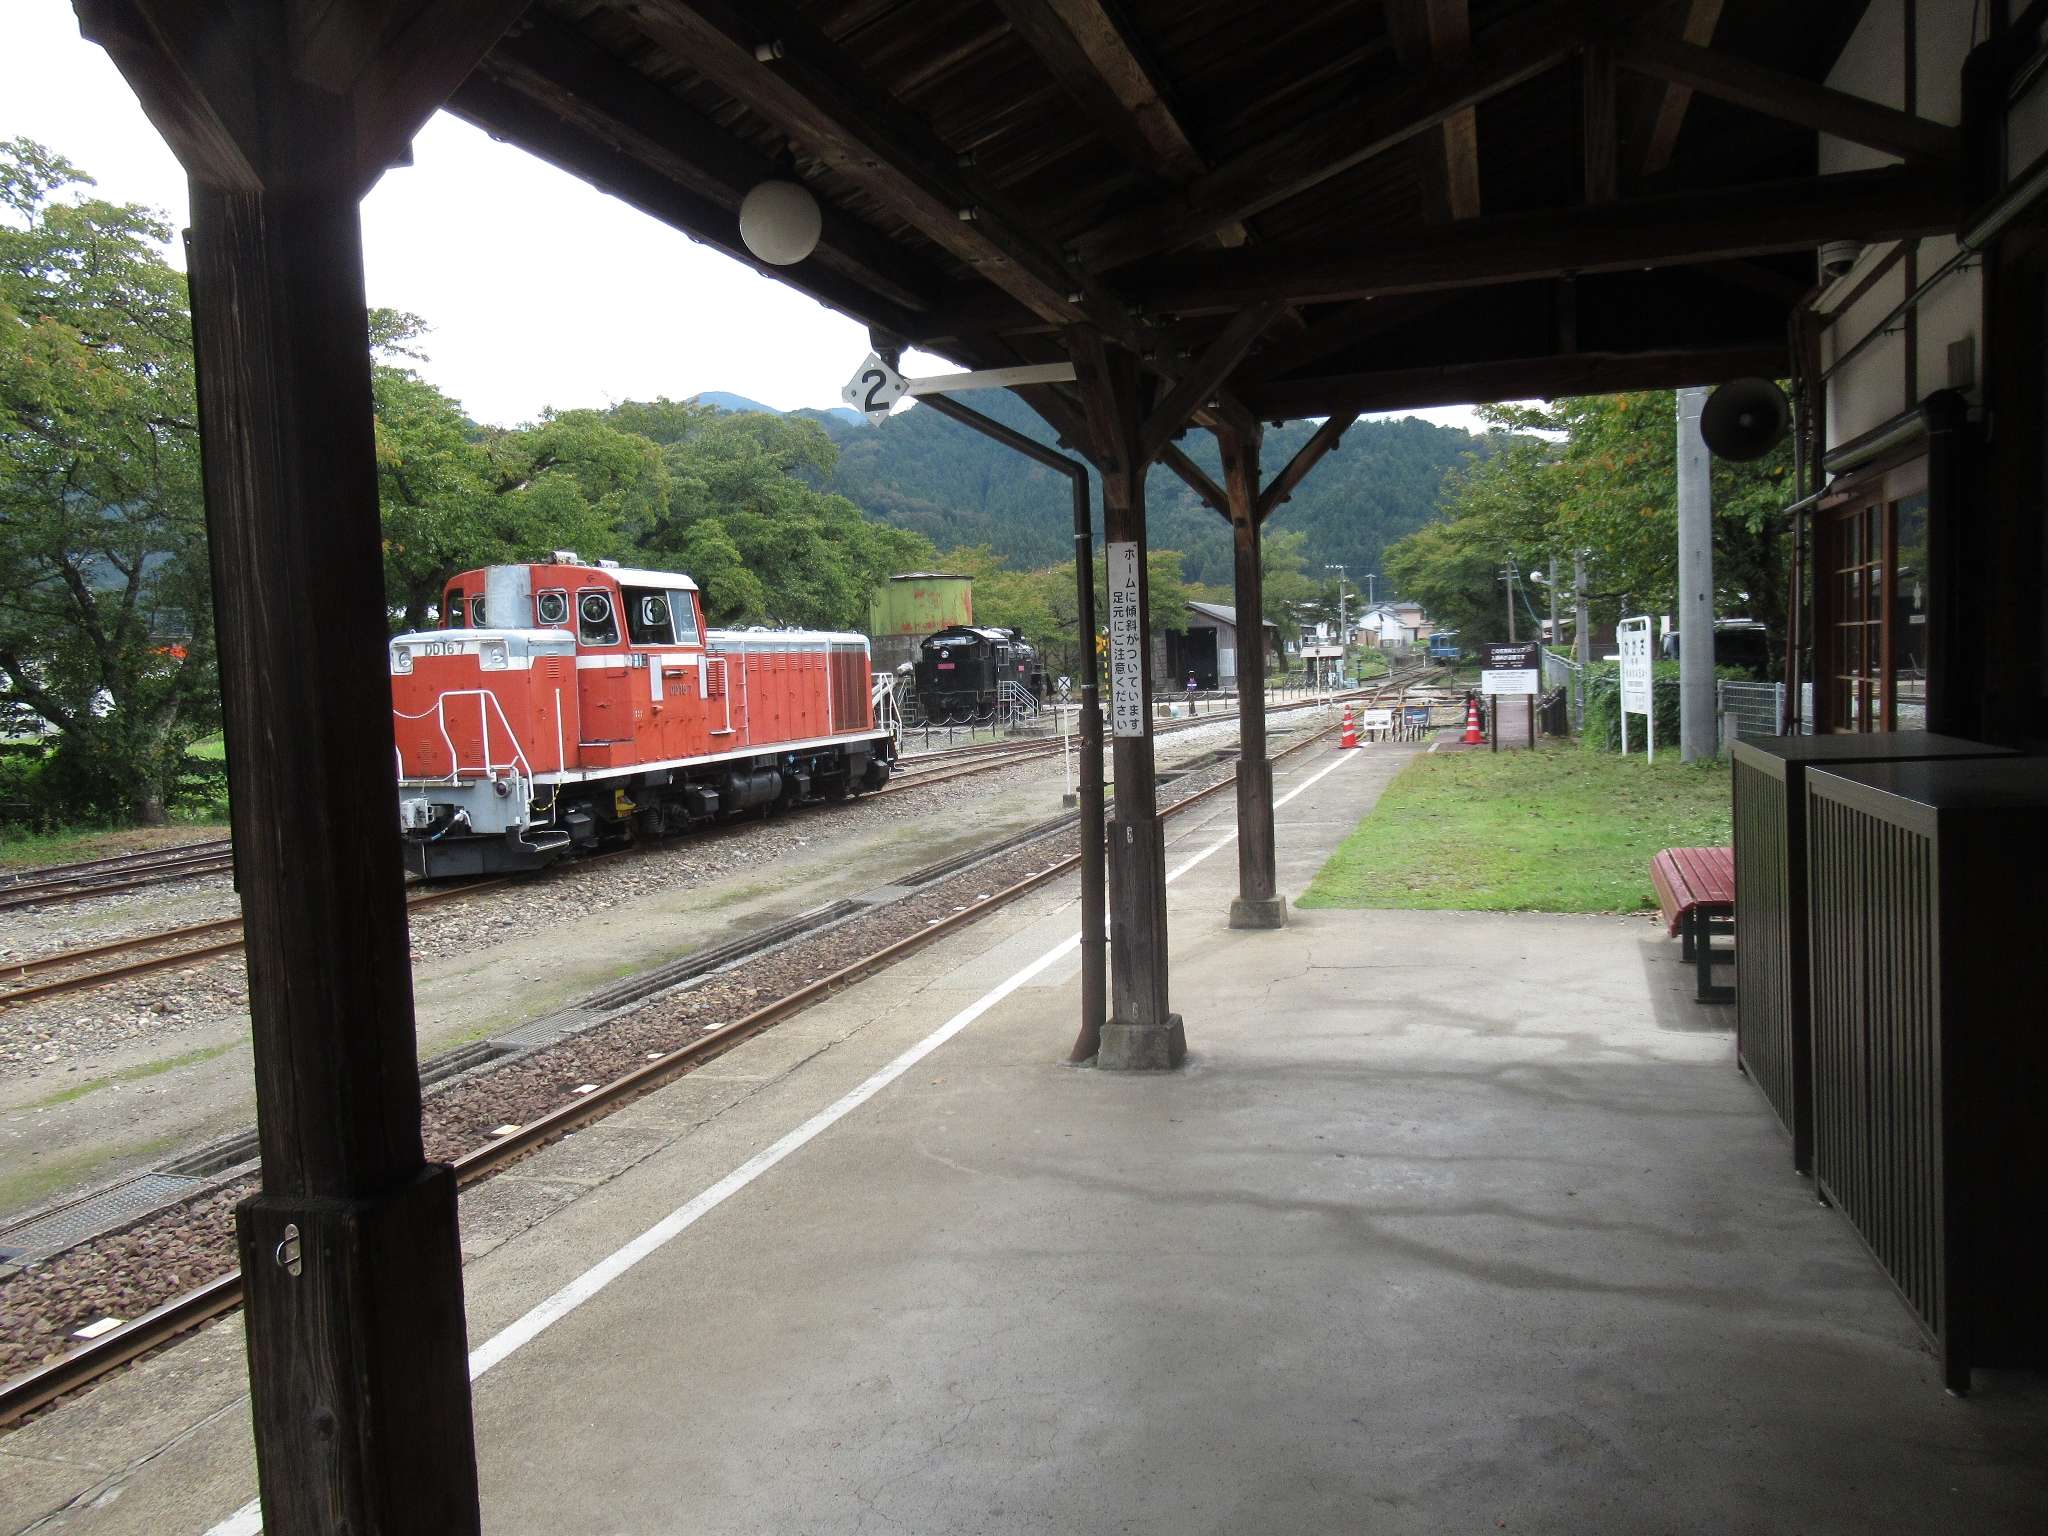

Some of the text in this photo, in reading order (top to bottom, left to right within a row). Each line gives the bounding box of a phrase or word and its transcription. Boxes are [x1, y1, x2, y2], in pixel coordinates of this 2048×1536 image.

[862, 369, 889, 412] 2
[1112, 591, 1128, 730] 足元にご注意ください
[1124, 548, 1140, 730] ホームに傾斜がついています
